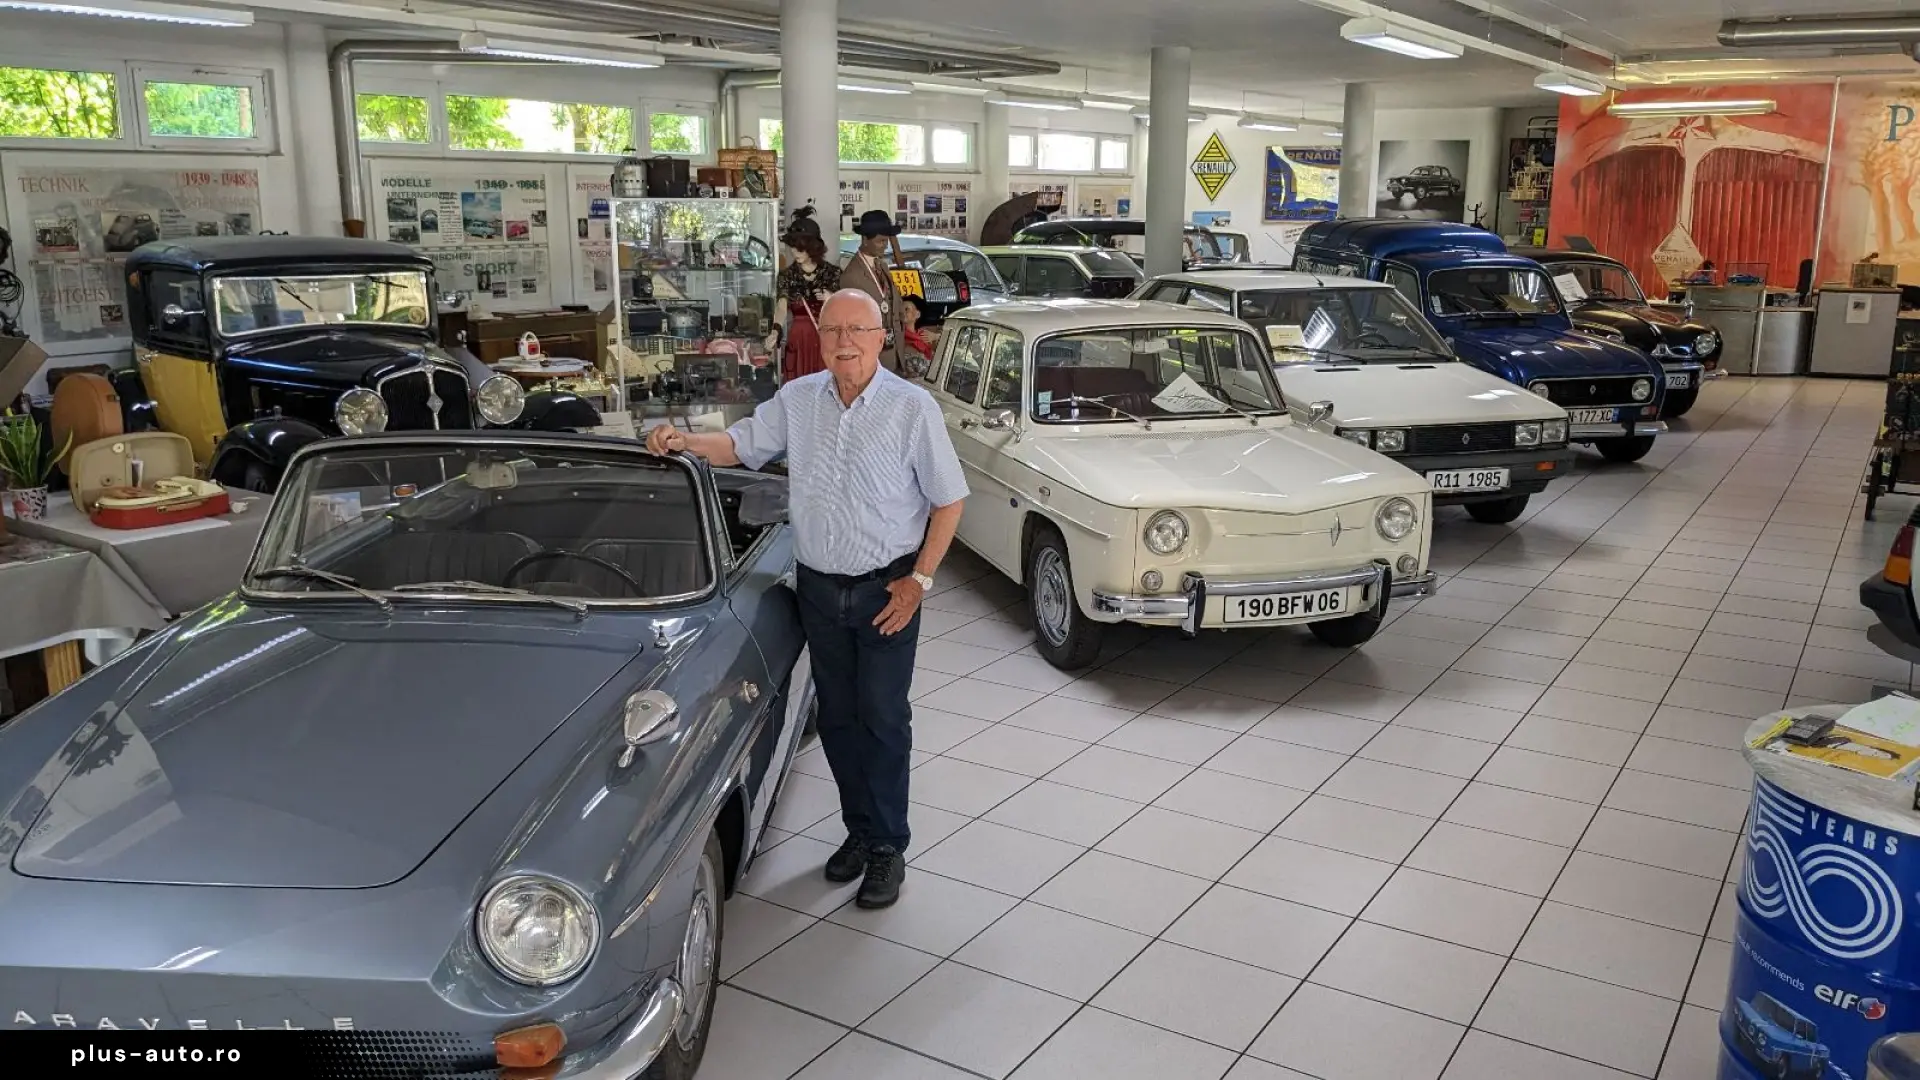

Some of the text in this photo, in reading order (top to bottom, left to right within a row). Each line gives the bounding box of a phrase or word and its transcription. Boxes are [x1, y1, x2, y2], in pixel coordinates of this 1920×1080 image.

[1884, 104, 1915, 142] P
[1288, 151, 1340, 161] RENAUL
[1196, 161, 1230, 174] RENAULT
[18, 176, 90, 193] TECHNIK
[1654, 254, 1697, 264] RENAULT
[463, 262, 517, 277] SPORT
[1668, 376, 1687, 386] 702
[1434, 471, 1502, 488] R11 1985
[1237, 591, 1340, 618] 190 BFW 06
[1810, 811, 1899, 856] YEARS
[1814, 984, 1860, 1010] elf
